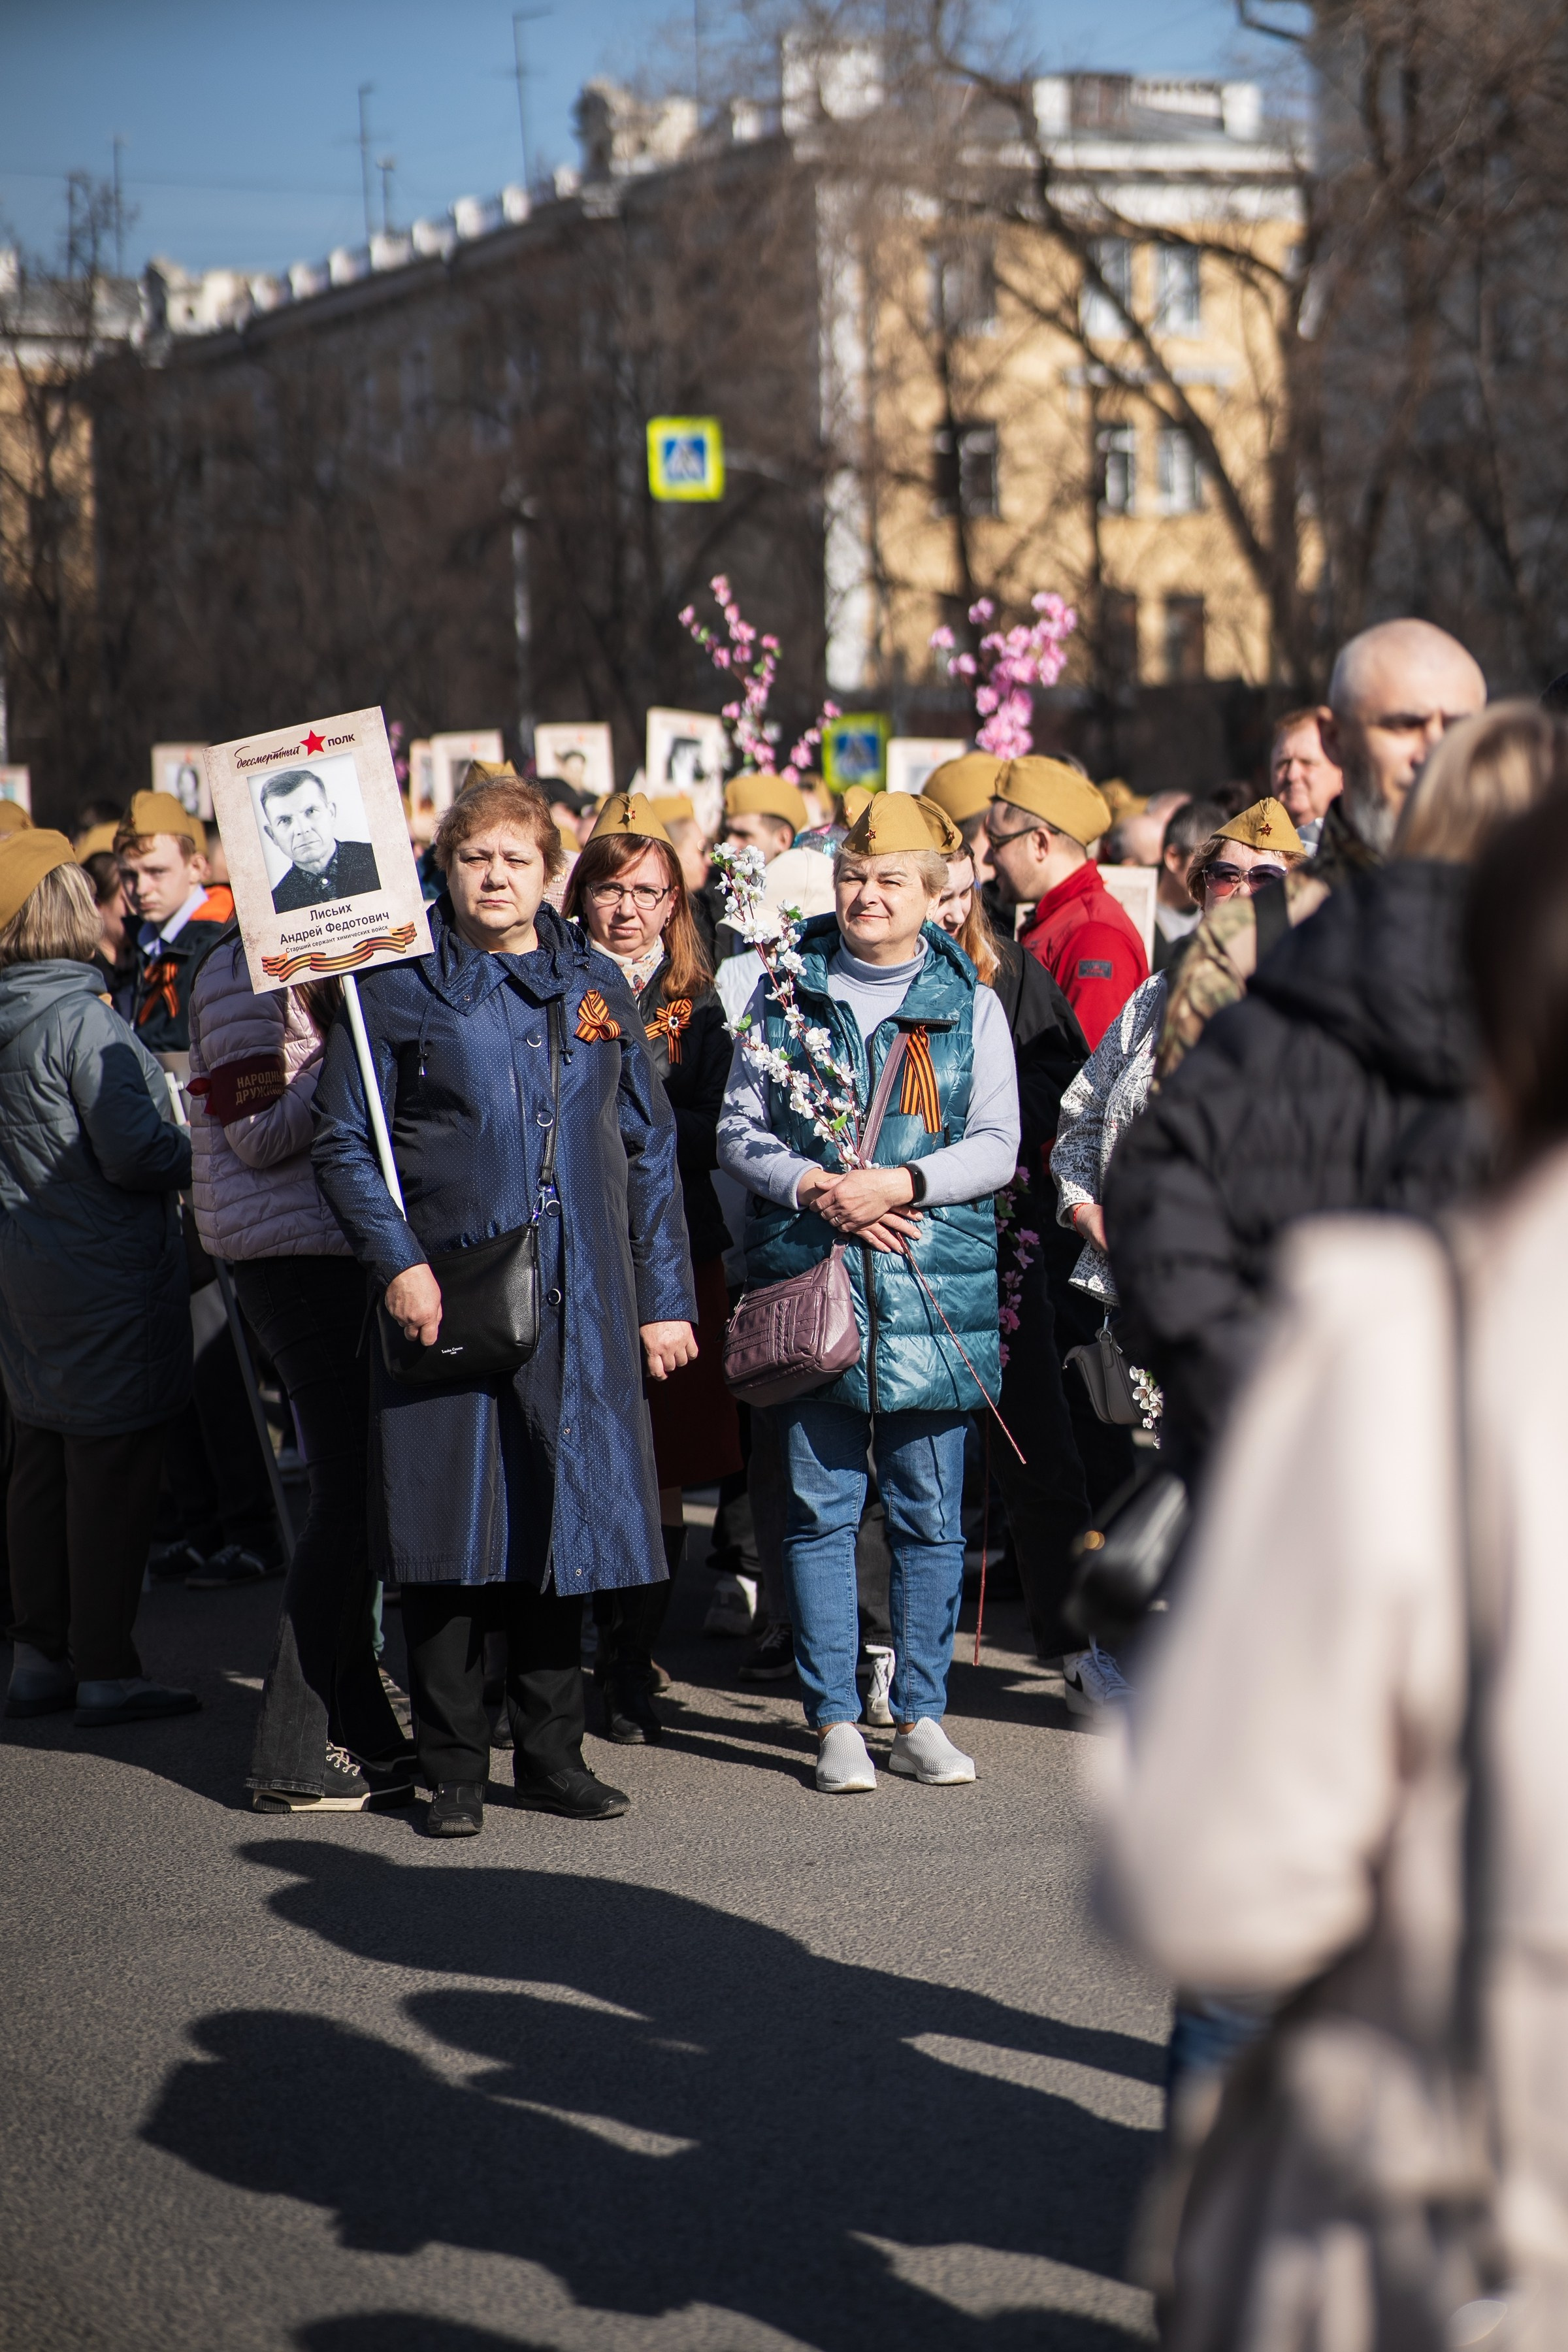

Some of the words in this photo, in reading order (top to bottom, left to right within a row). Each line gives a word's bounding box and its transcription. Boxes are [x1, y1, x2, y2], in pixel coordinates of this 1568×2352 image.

[310, 904, 352, 921] Лисьих
[280, 925, 323, 945] Андрей
[325, 911, 390, 933] Федотович
[286, 943, 312, 953] Старший
[312, 937, 336, 947] сержант
[336, 928, 370, 941] химических
